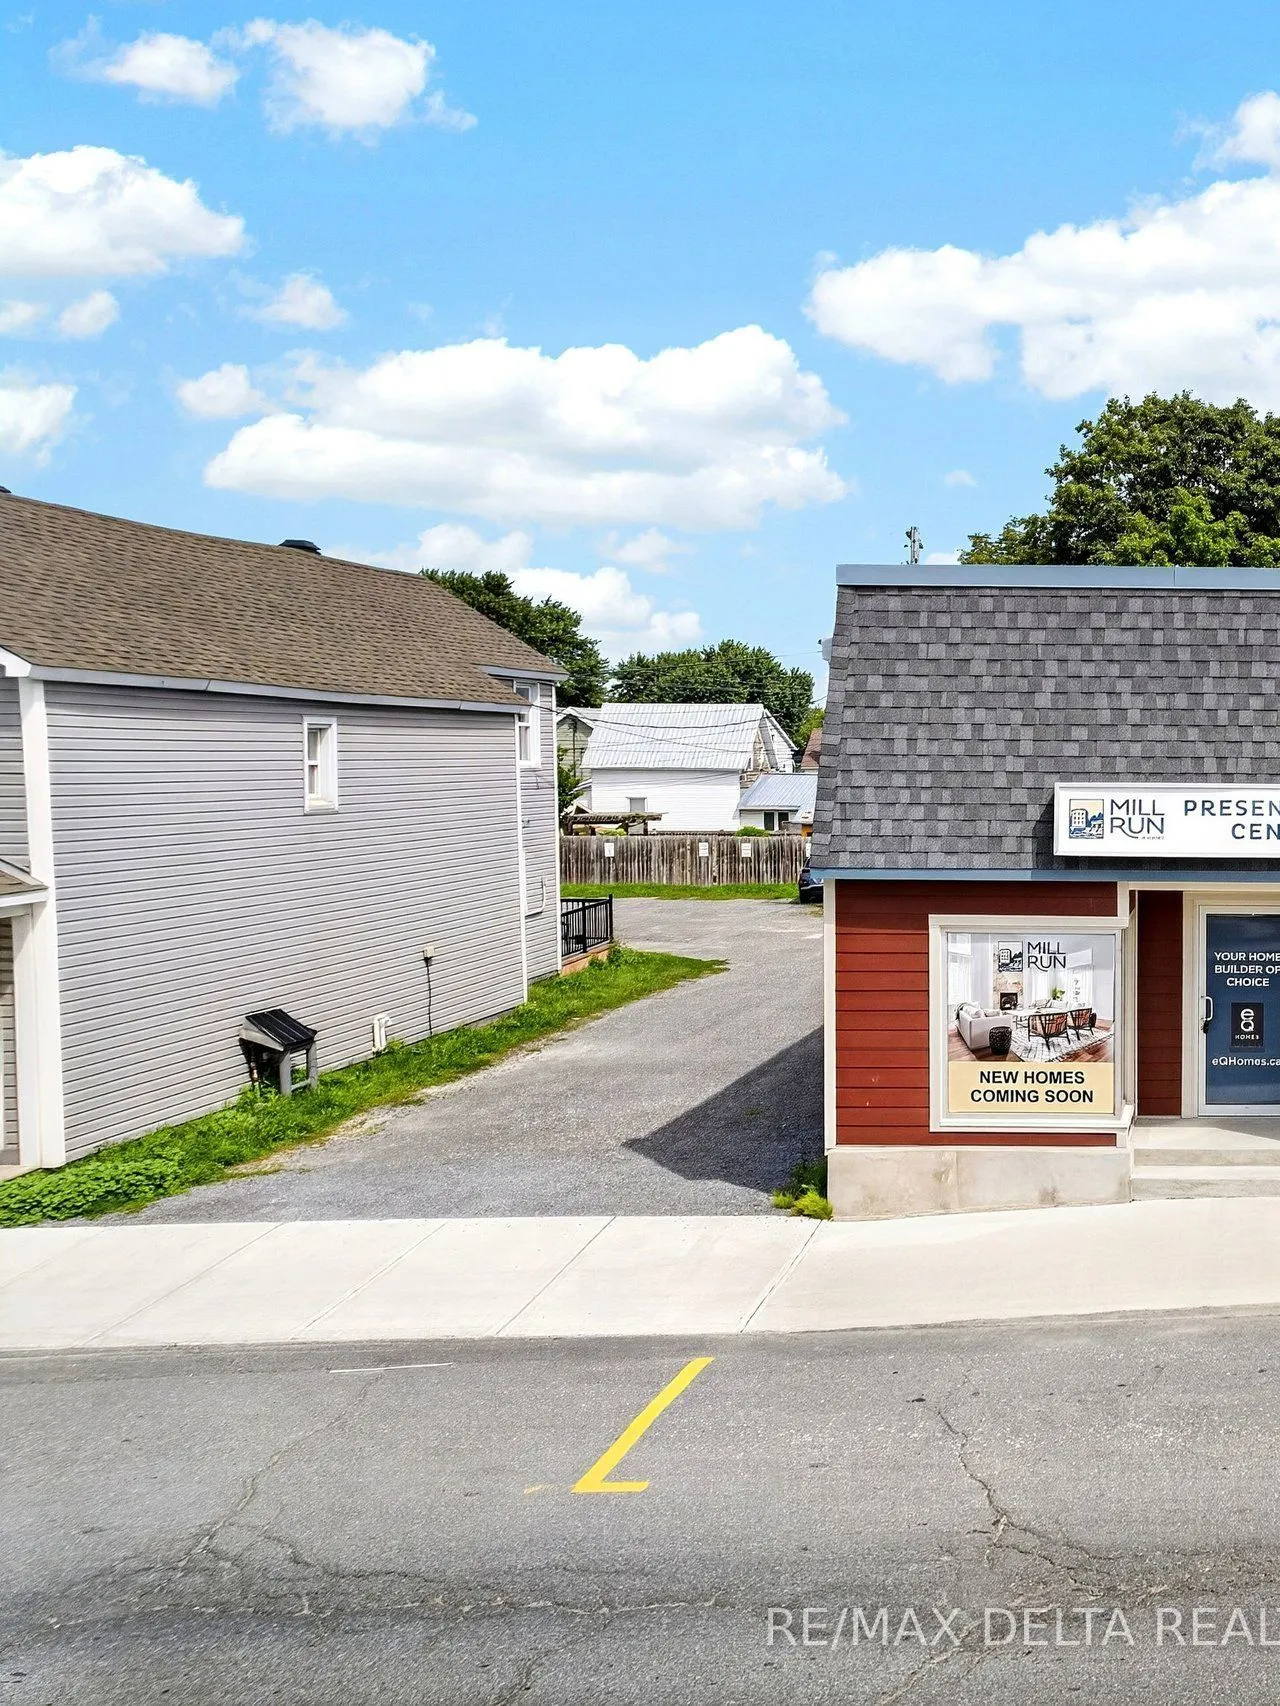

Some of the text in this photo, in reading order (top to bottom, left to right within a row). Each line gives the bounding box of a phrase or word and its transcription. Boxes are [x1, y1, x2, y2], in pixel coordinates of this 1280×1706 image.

[1110, 798, 1165, 816] MILL
[1110, 817, 1165, 839] RUN
[1027, 941, 1066, 955] MILL
[1027, 955, 1066, 972] RUN
[1214, 952, 1246, 961] YOUR
[1214, 965, 1263, 974] BUILDER
[1226, 977, 1270, 987] CHOICE
[979, 1070, 1085, 1084] NEW HOMES
[971, 1089, 1094, 1103] COMING SOON
